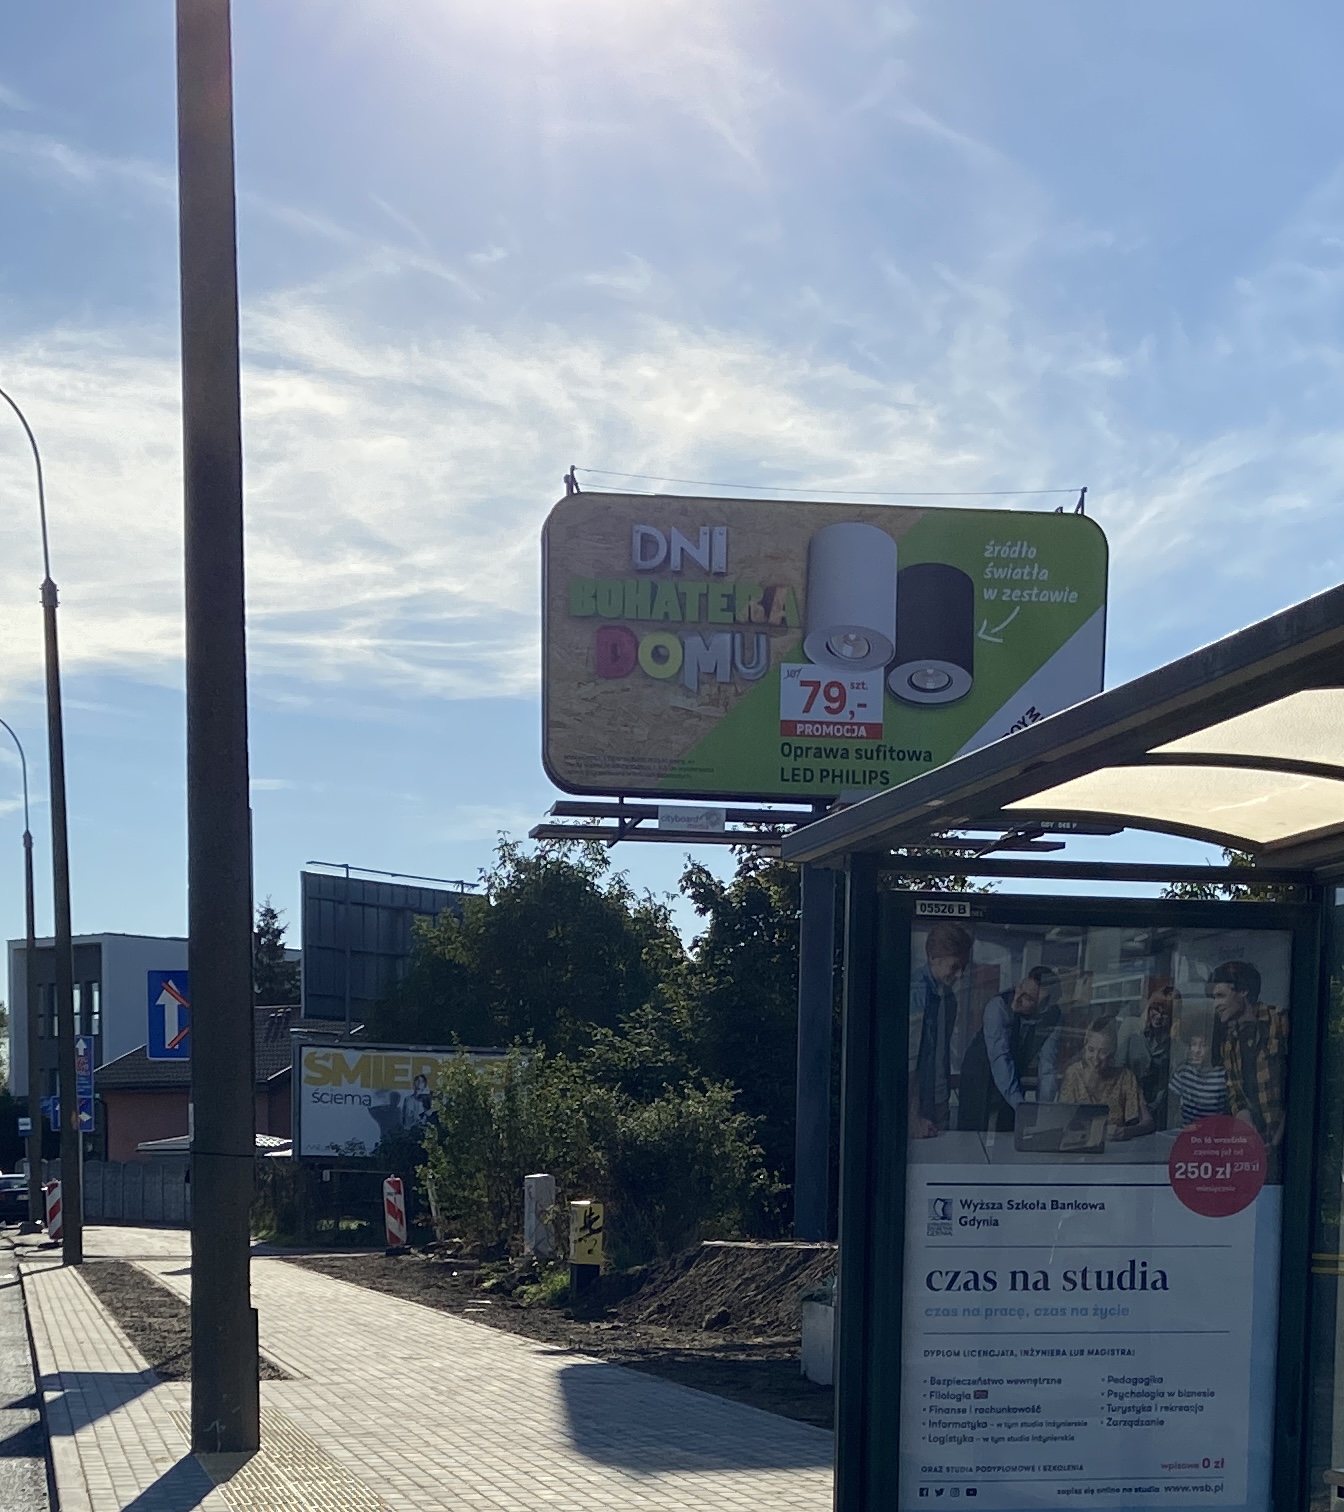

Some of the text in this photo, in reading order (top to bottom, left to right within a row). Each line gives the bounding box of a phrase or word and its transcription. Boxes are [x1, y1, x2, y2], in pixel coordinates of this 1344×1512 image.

[632, 524, 727, 574] DNI
[984, 540, 1037, 559] źródło
[983, 562, 1049, 580] światła
[570, 575, 800, 627] BOHATERA
[983, 586, 1078, 603] w zestawie
[595, 625, 768, 692] DOMU
[850, 681, 869, 691] szt.
[796, 724, 867, 737] PROMOCJA
[781, 742, 933, 762] Oprawa sufitowa
[780, 767, 890, 785] LED PHILIPS
[919, 902, 954, 914] 05526
[958, 903, 967, 914] B
[312, 1088, 372, 1106] ściema
[1175, 1162, 1213, 1179] 250
[1216, 1162, 1232, 1179] zł
[959, 1199, 1106, 1213] Wyższa Szkoła Bankowa
[959, 1216, 1000, 1229] Gdynia
[925, 1259, 1170, 1292] czas na studia
[924, 1306, 958, 1317] czas
[962, 1306, 981, 1317] na
[1033, 1305, 1067, 1317] czas
[1070, 1305, 1089, 1317] na
[1092, 1304, 1130, 1319] życie
[923, 1349, 961, 1358] DYPLOM
[1069, 1349, 1085, 1357] LUB
[930, 1376, 1004, 1388] Bezpieczeństwo
[1107, 1375, 1164, 1386] Pedagogika
[929, 1391, 971, 1402] Filologia
[1106, 1389, 1165, 1400] Psychologia
[1177, 1388, 1216, 1398] biznesie
[929, 1405, 967, 1415] Finanse
[974, 1404, 1042, 1415] rachunkowość
[1106, 1403, 1153, 1414] Turystyka
[1159, 1403, 1205, 1414] rekreacja
[928, 1419, 988, 1431] Informatyka
[1106, 1417, 1165, 1428] Zarządzanie
[928, 1434, 974, 1446] Logistyka
[1164, 1482, 1224, 1495] www.wsb.pl
